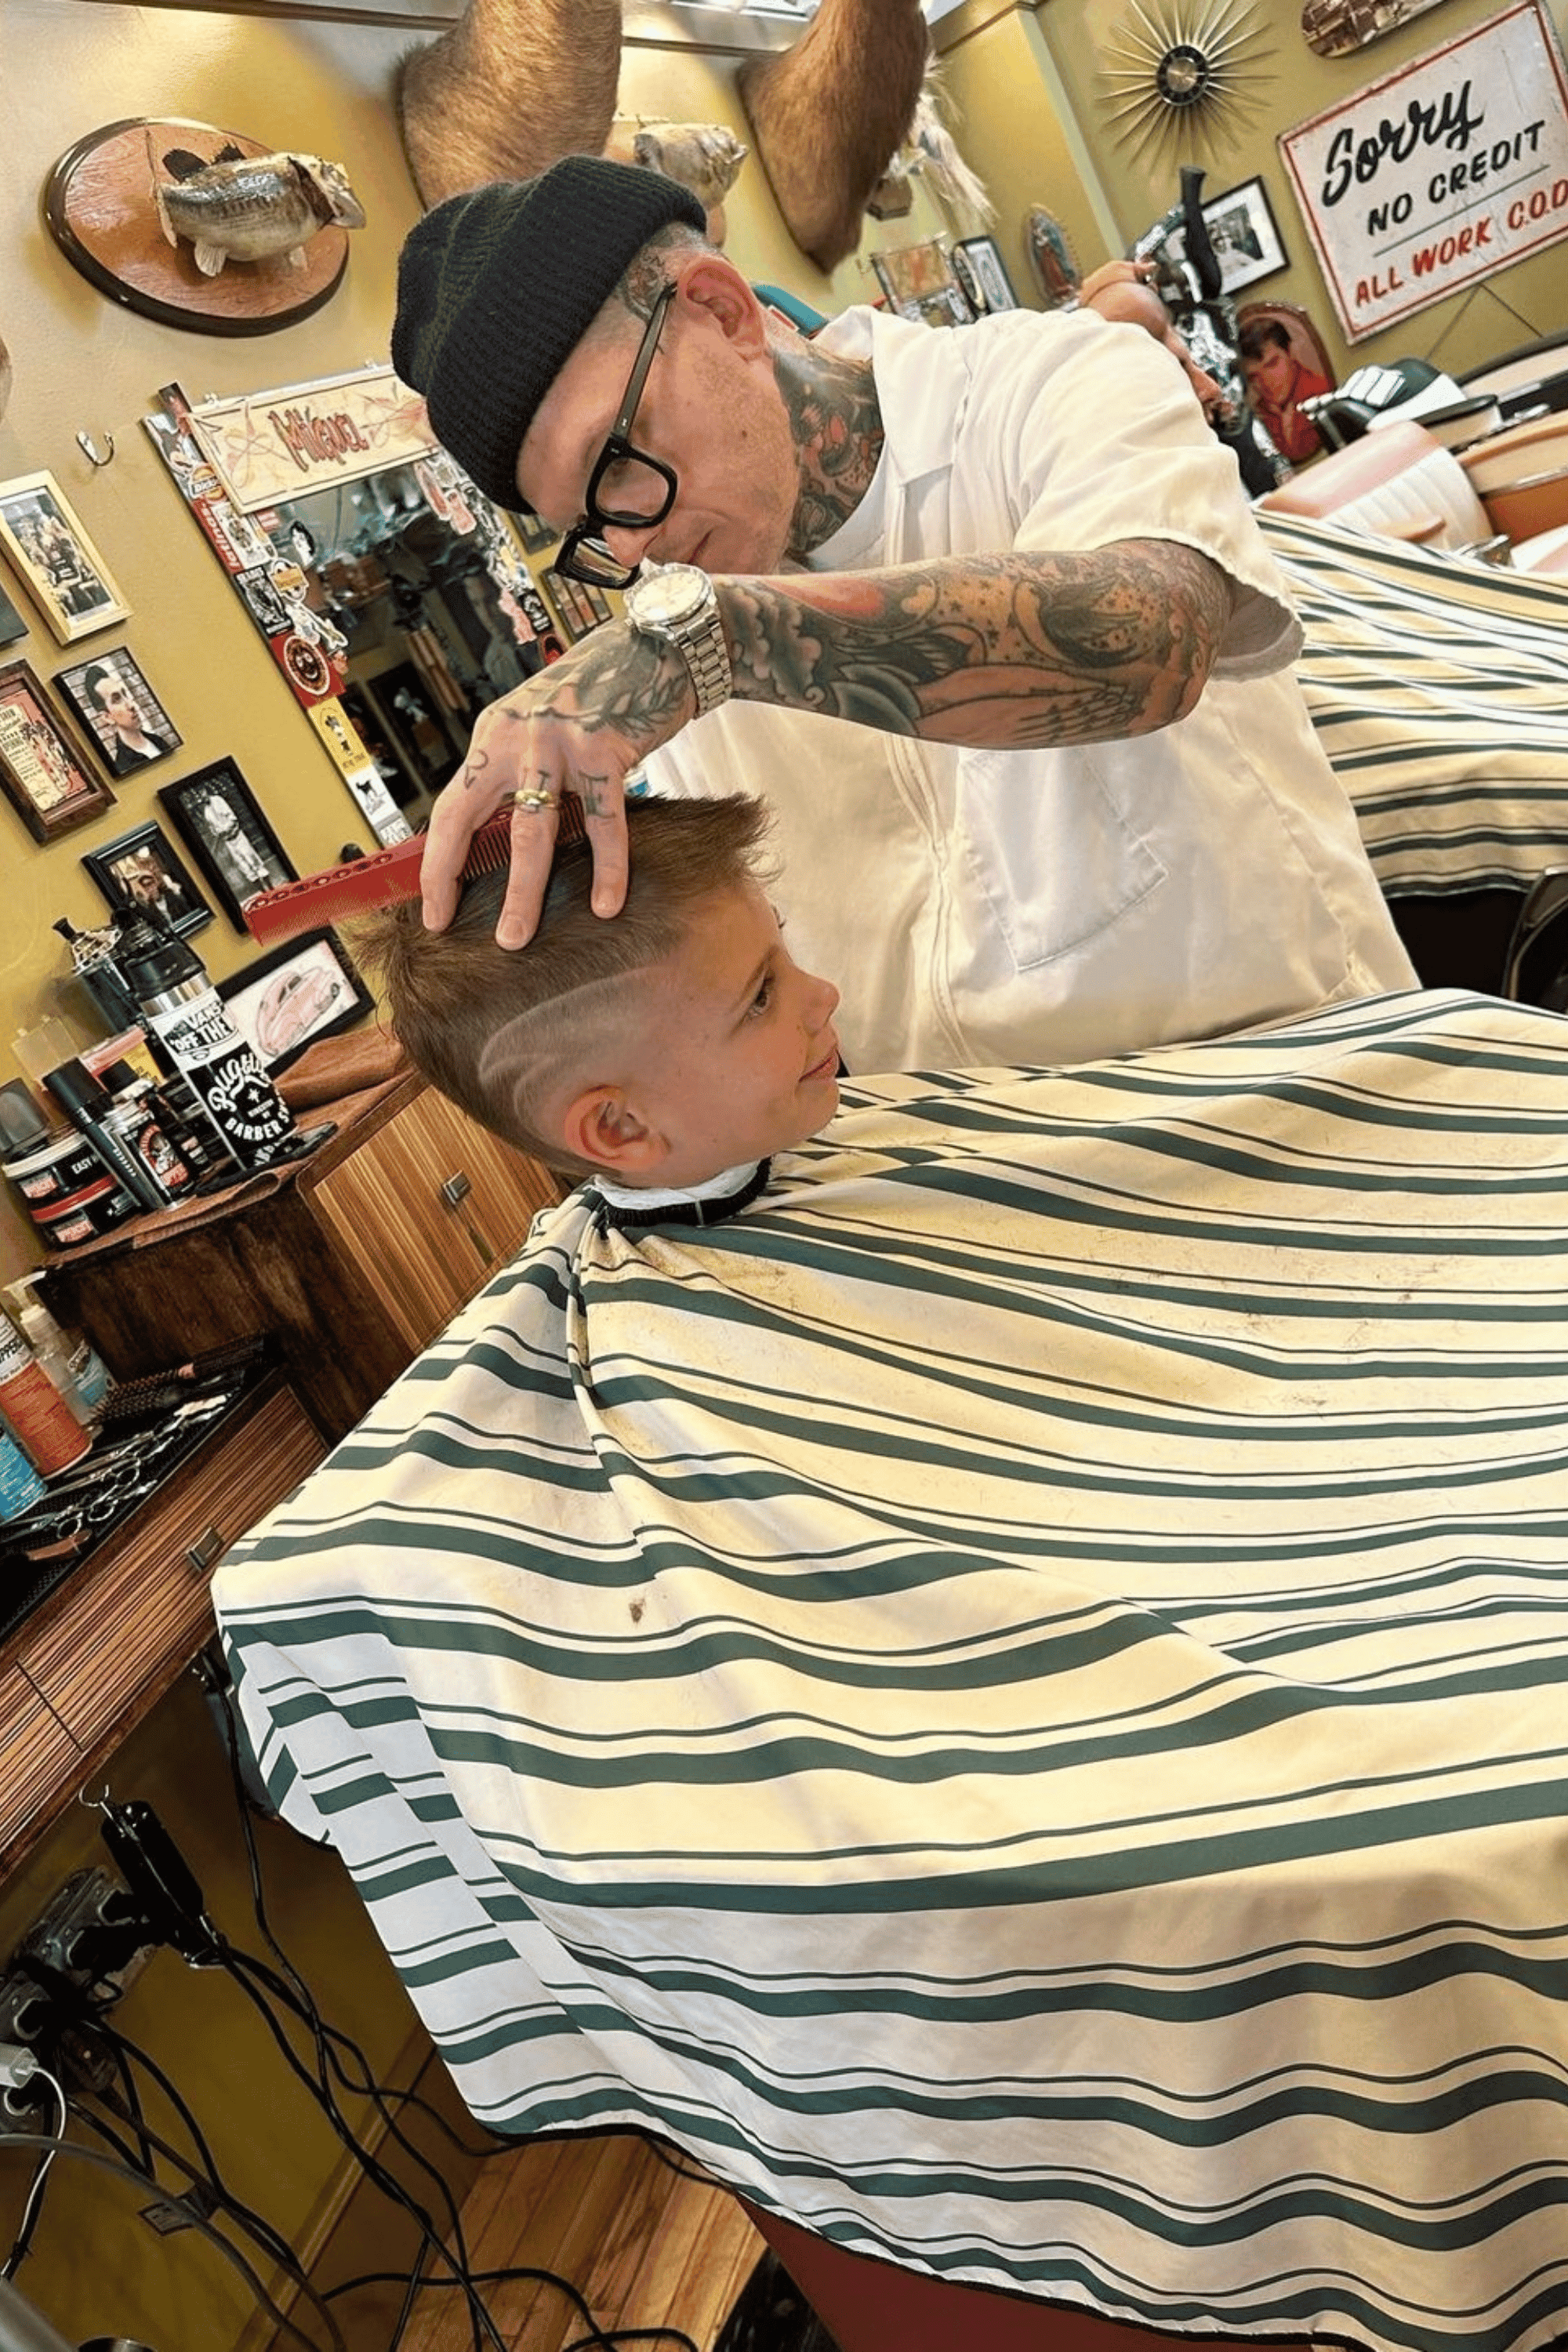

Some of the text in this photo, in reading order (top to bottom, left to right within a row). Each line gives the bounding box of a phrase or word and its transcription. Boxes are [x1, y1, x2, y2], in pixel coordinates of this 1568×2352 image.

[1322, 81, 1484, 207] Sorry
[1367, 121, 1544, 235] NO CREDIT
[1356, 267, 1404, 307] ALL
[1413, 217, 1492, 277] WORK
[225, 1118, 282, 1141] BARBER
